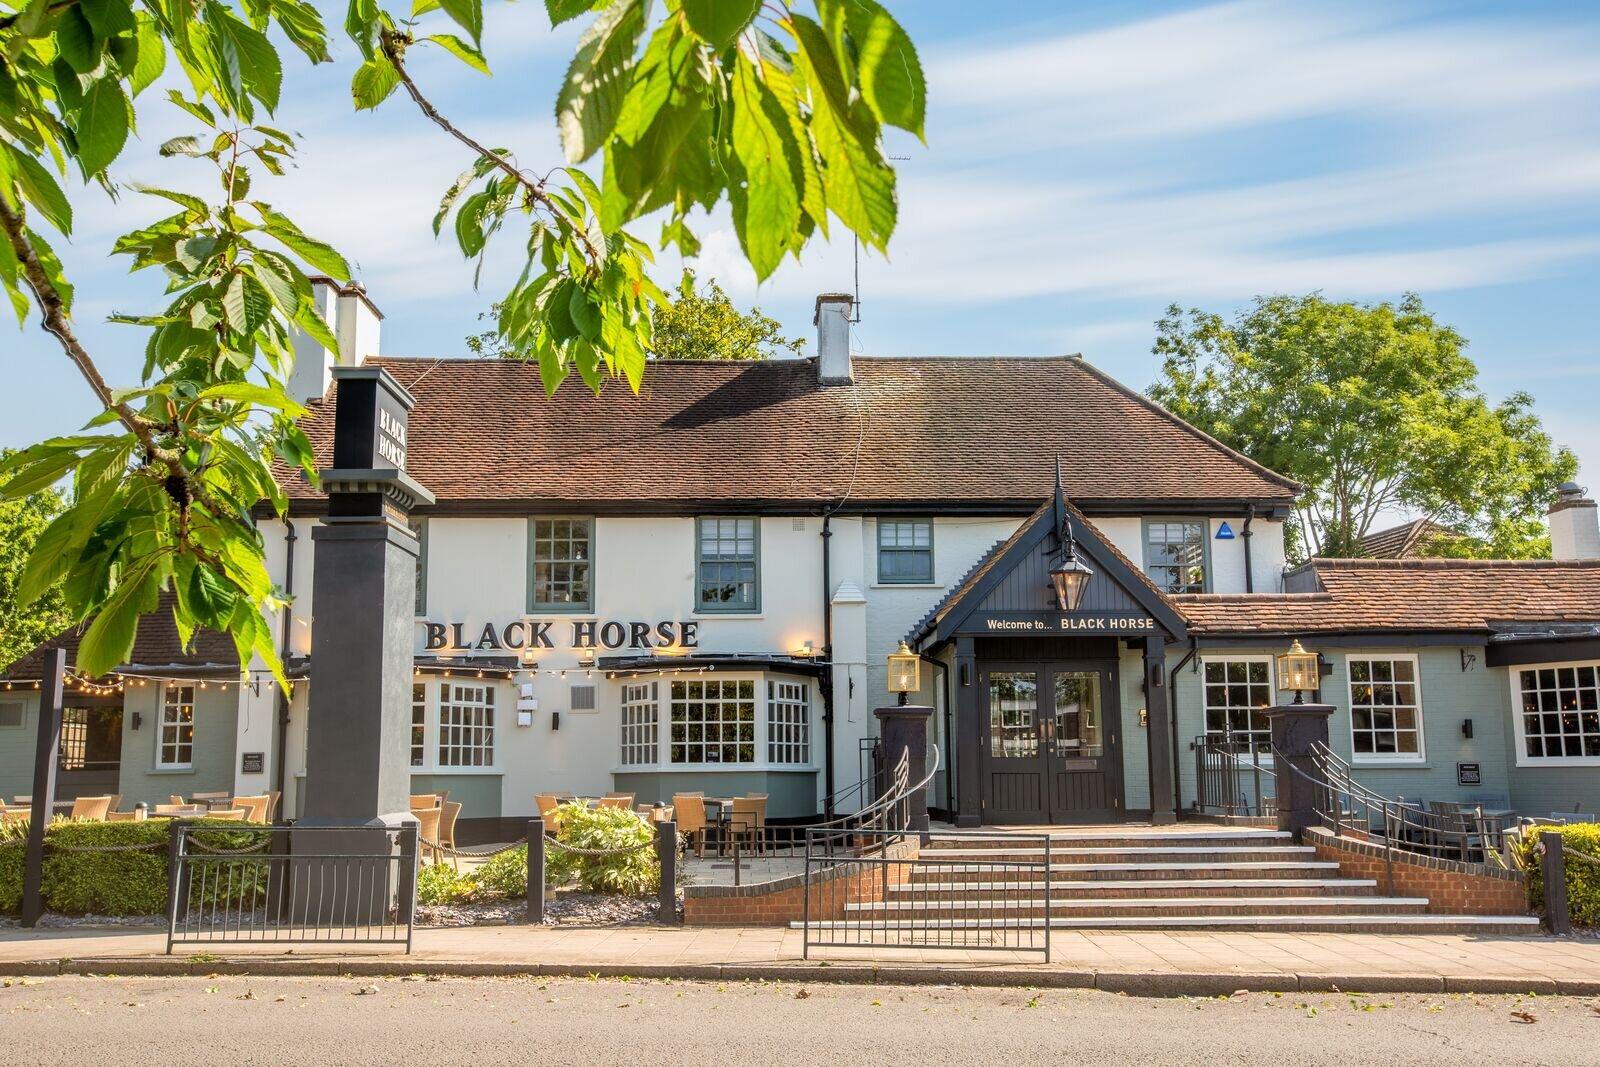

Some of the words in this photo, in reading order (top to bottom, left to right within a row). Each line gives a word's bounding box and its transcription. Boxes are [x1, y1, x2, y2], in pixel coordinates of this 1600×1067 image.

[379, 408, 406, 447] BLACK
[378, 434, 405, 471] HORSE
[424, 621, 554, 650] BLACK
[570, 621, 699, 650] HORSE
[987, 619, 1033, 630] Welcome
[1034, 619, 1053, 630] to...
[1061, 618, 1105, 629] BLACK
[1109, 618, 1154, 629] HORSE
